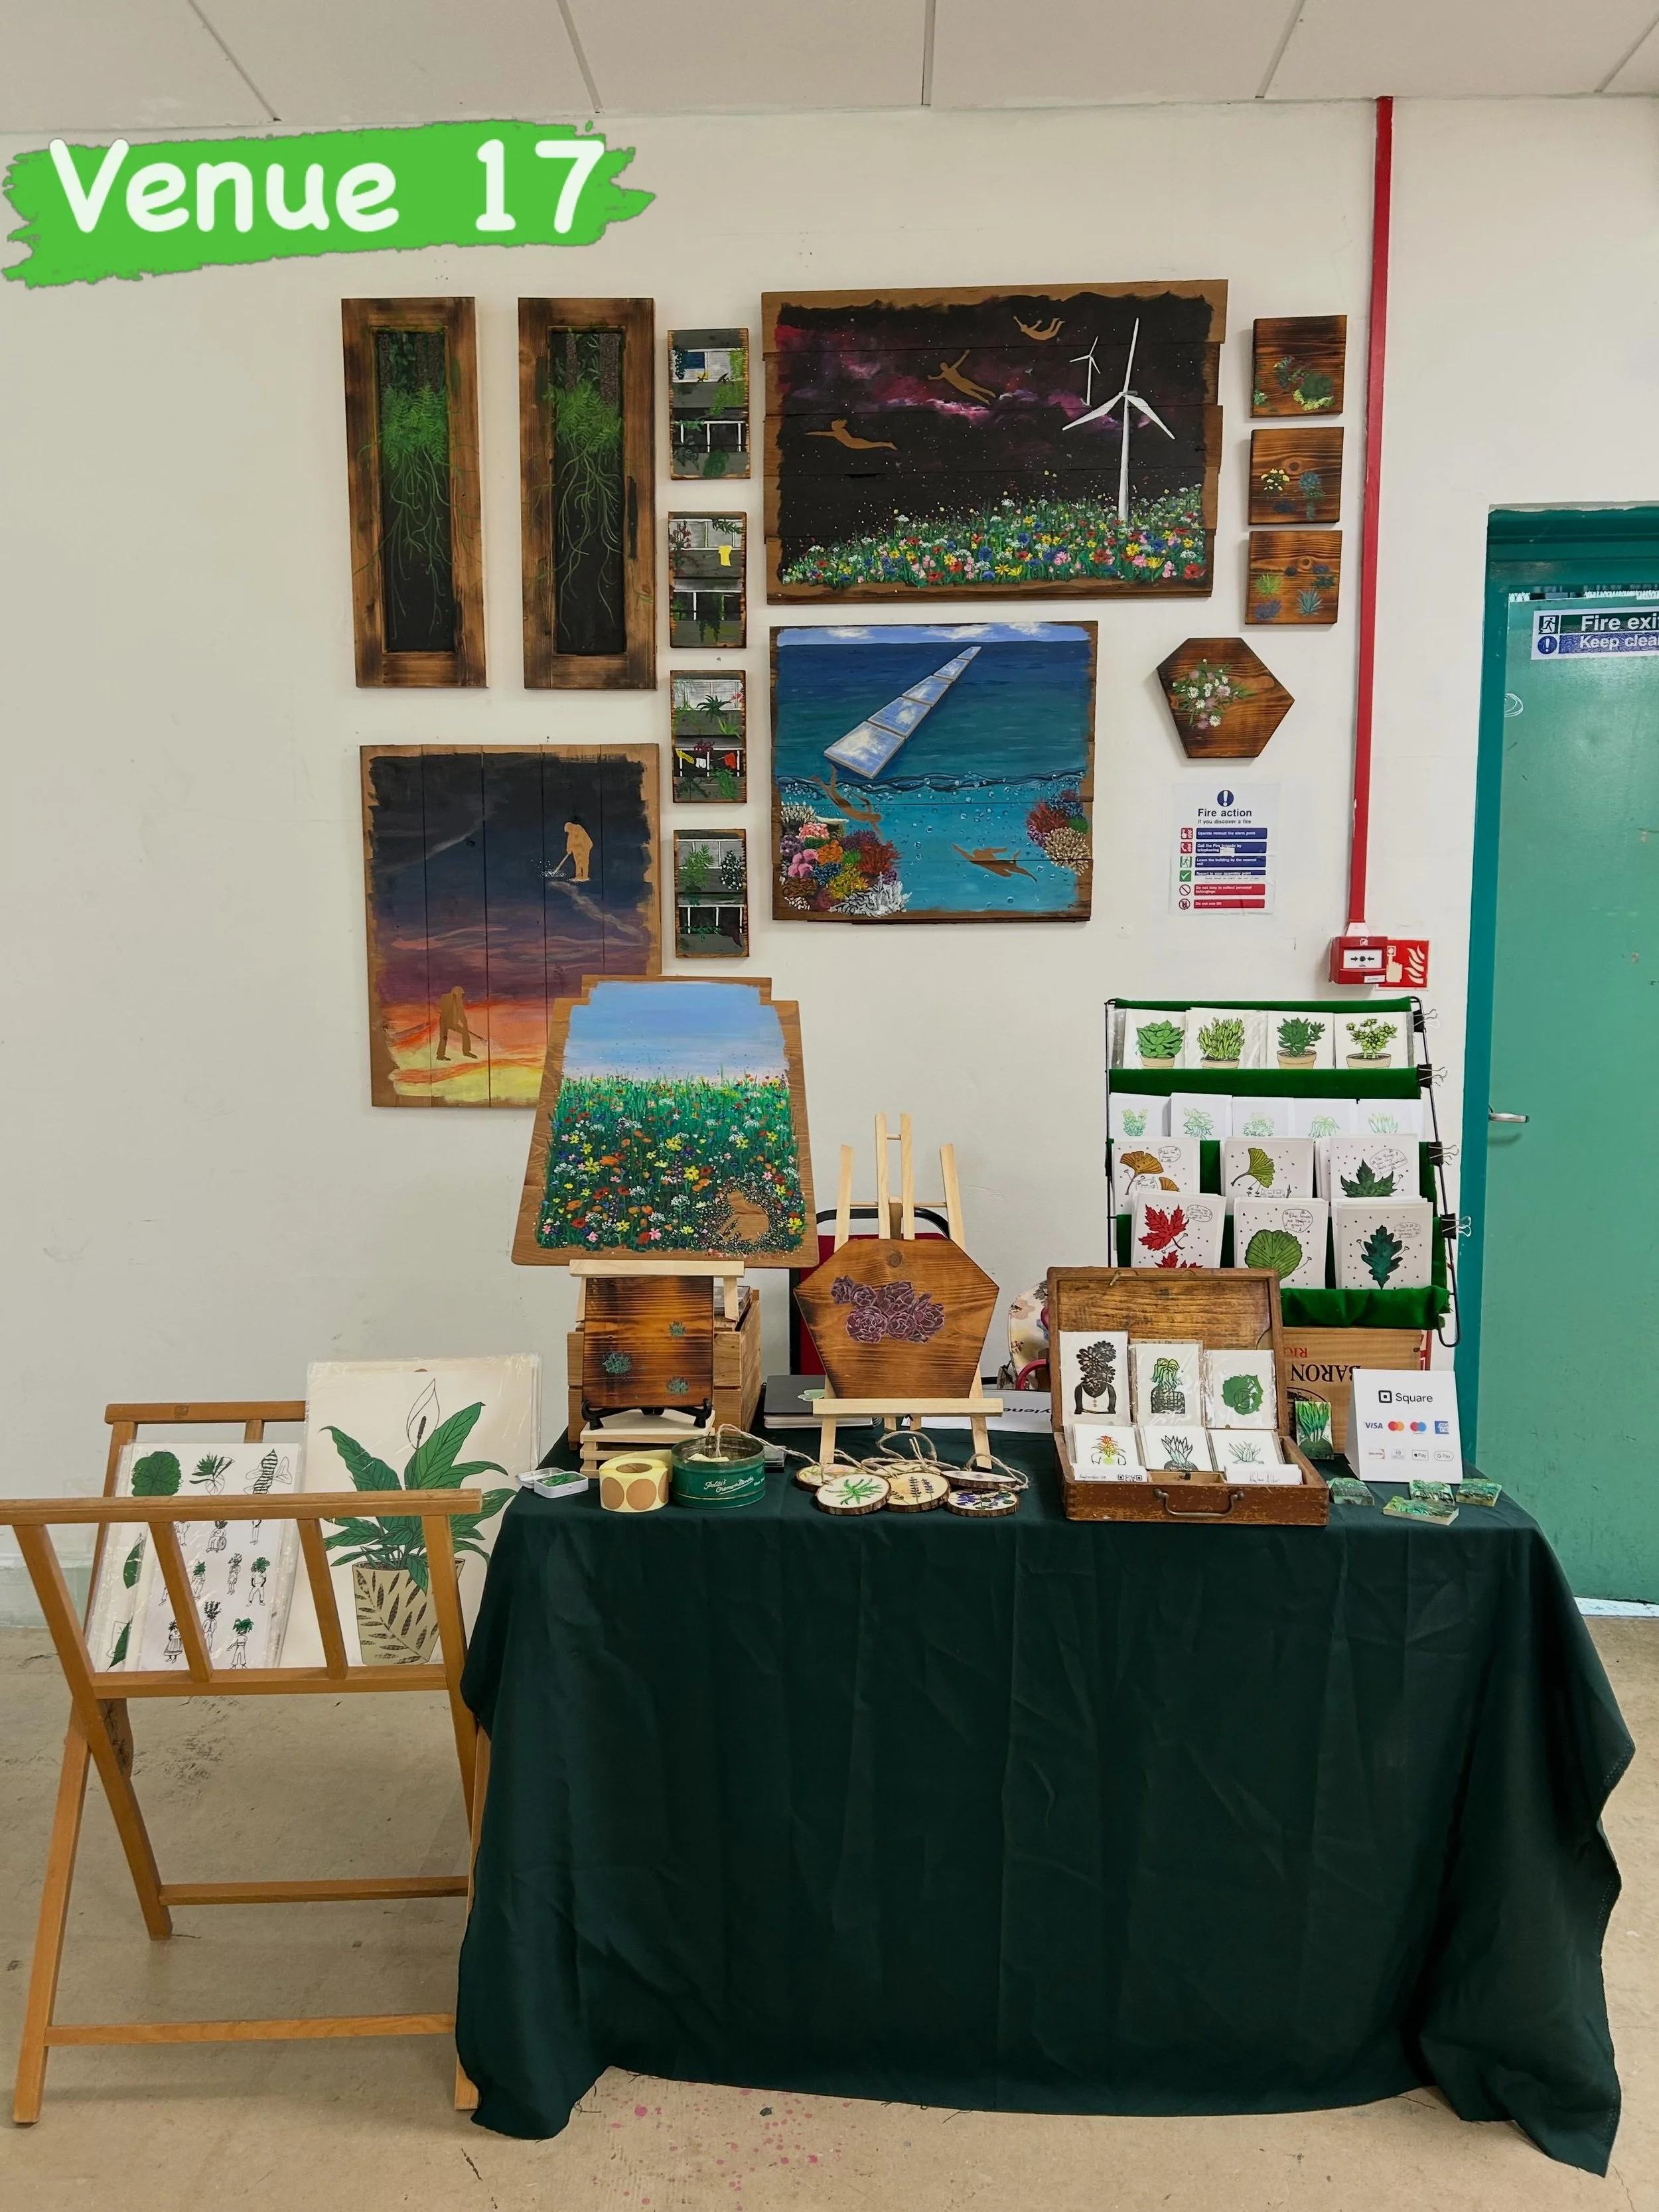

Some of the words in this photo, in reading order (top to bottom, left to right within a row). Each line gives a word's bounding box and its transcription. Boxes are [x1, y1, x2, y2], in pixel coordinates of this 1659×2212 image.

[1581, 615, 1621, 631] Fire
[1627, 613, 1659, 630] exi
[1579, 634, 1620, 650] Keep
[1624, 634, 1659, 647] clea
[1198, 808, 1217, 817] Fire
[1220, 808, 1252, 817] action
[1395, 1392, 1433, 1404] Square
